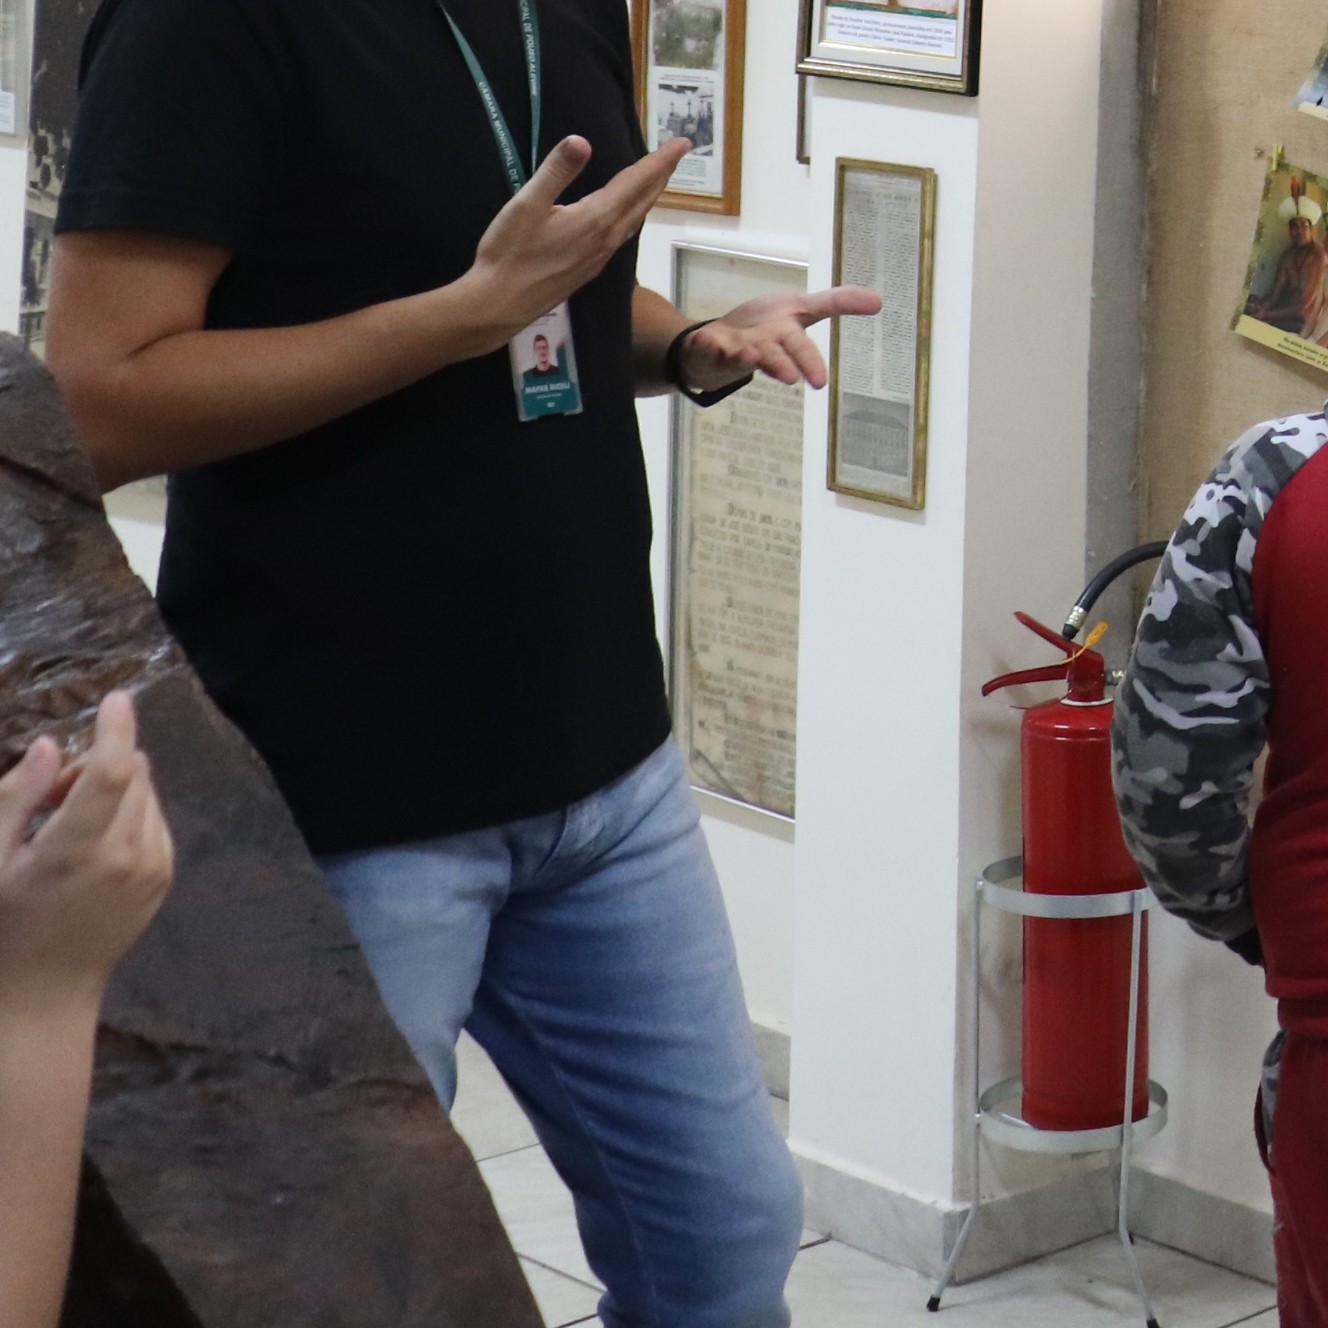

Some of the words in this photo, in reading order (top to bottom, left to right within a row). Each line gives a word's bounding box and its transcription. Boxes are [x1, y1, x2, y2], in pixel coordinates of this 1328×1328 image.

[523, 22, 532, 34] DE
[478, 80, 498, 119] CÂMARA
[494, 119, 515, 168] MUNICIPAL
[508, 167, 519, 182] DE
